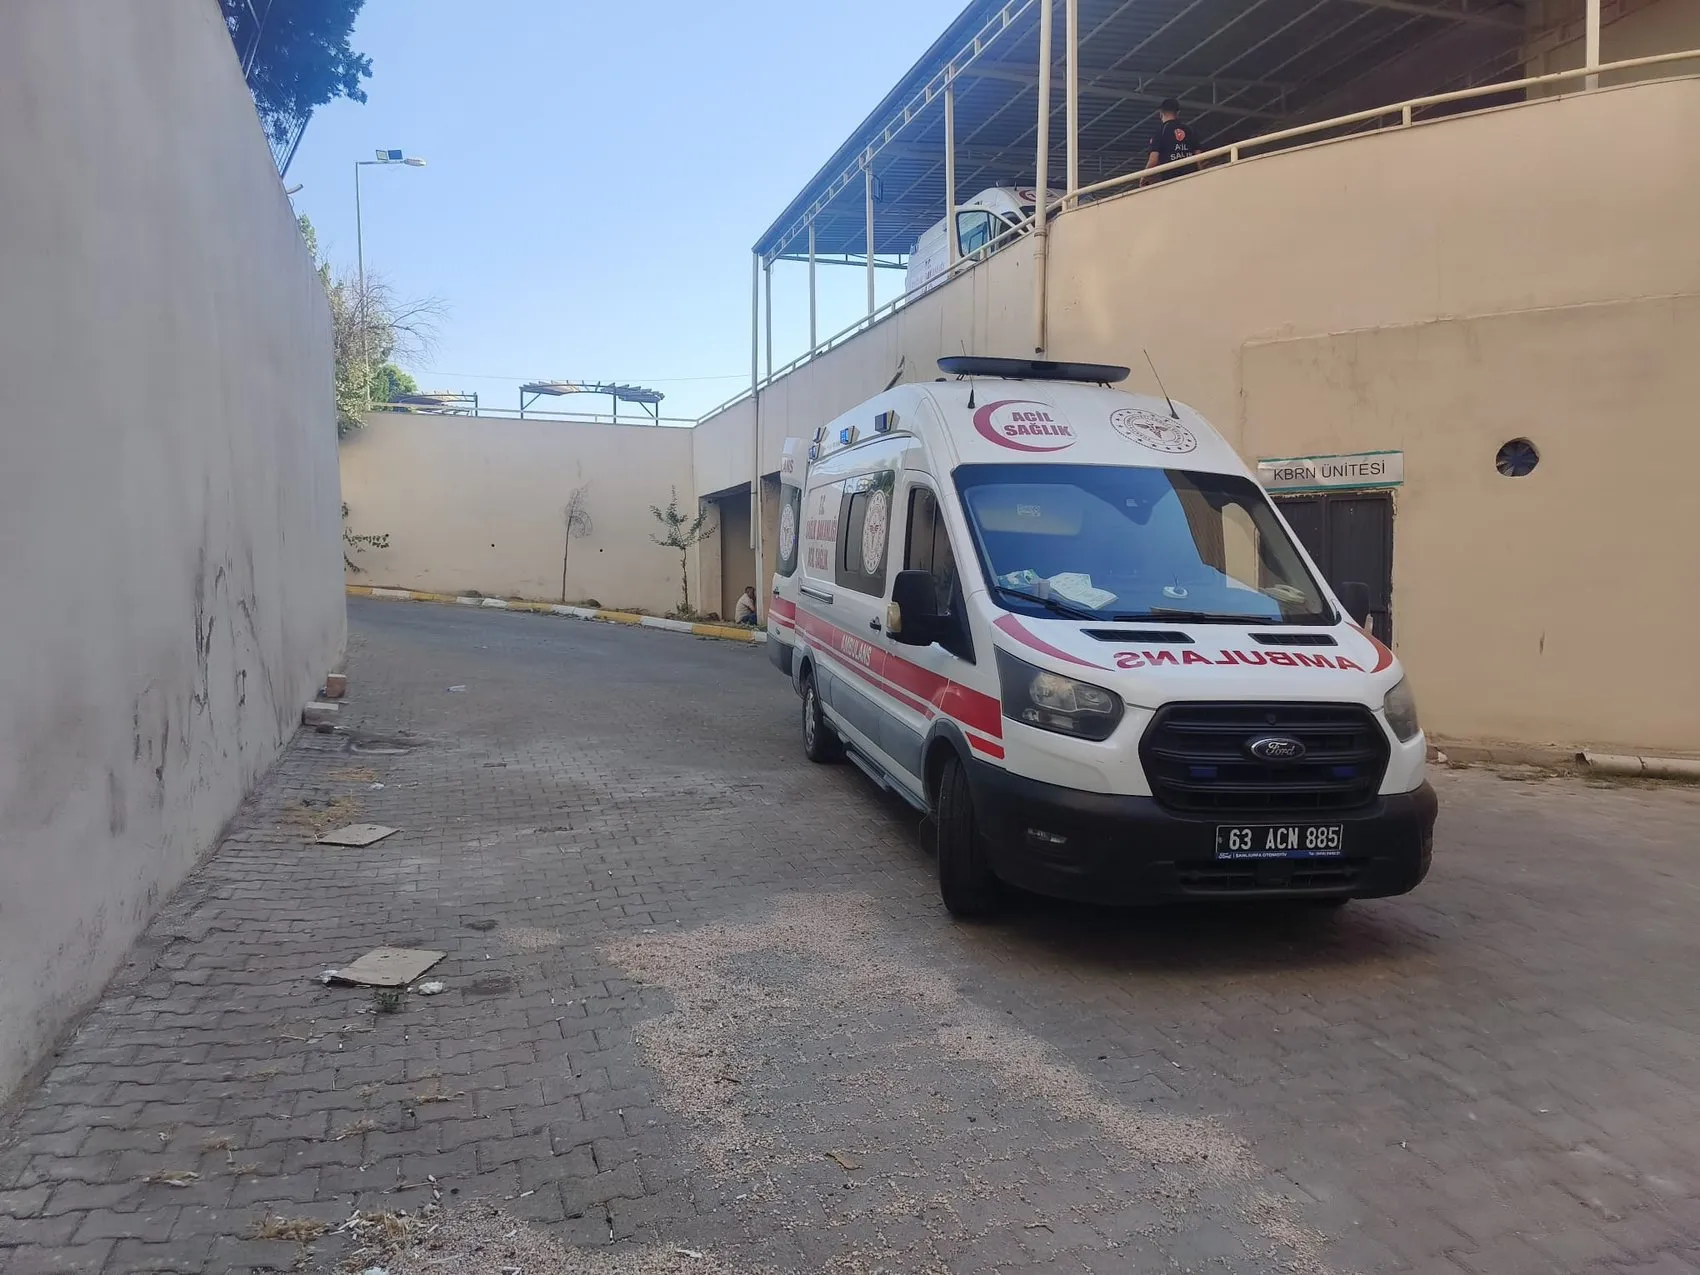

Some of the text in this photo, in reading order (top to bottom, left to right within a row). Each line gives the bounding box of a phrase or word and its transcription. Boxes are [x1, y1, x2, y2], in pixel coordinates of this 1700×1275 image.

[1012, 410, 1054, 422] ACİL
[1004, 422, 1073, 437] SAĞLIK
[1273, 459, 1386, 481] KBRN ÜNİTESİ
[1265, 741, 1296, 756] Ford
[1229, 826, 1339, 850] 63 ACN 885
